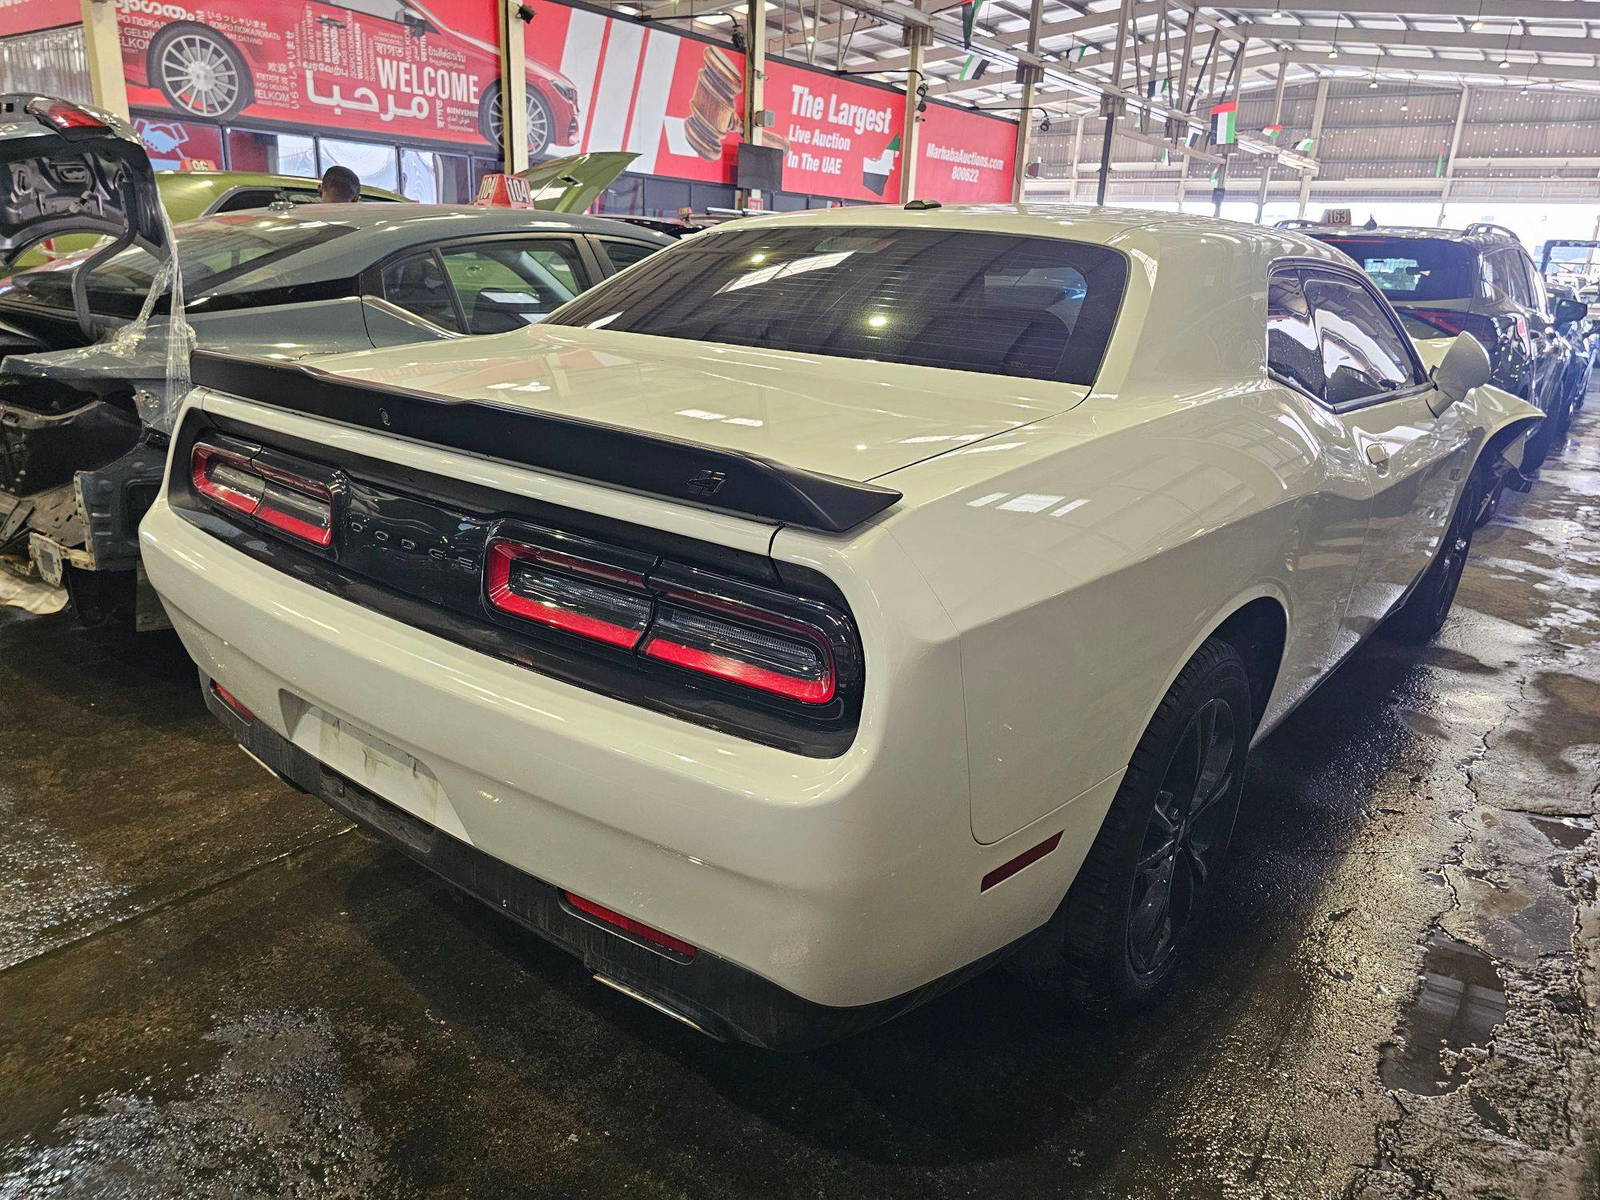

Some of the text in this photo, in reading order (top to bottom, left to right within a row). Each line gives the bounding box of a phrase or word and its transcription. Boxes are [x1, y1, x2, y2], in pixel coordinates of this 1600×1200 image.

[376, 56, 480, 105] WELCOME
[305, 69, 430, 122] مرحبا
[791, 84, 892, 135] The Largest
[788, 124, 851, 152] Live Auction
[787, 151, 842, 176] In The UAE
[925, 142, 1005, 172] MarhabaAuctions.com
[481, 177, 496, 200] 104
[951, 168, 980, 184] 800622
[508, 178, 529, 203] 104
[1329, 209, 1346, 223] 163
[351, 521, 475, 570] DODGE
